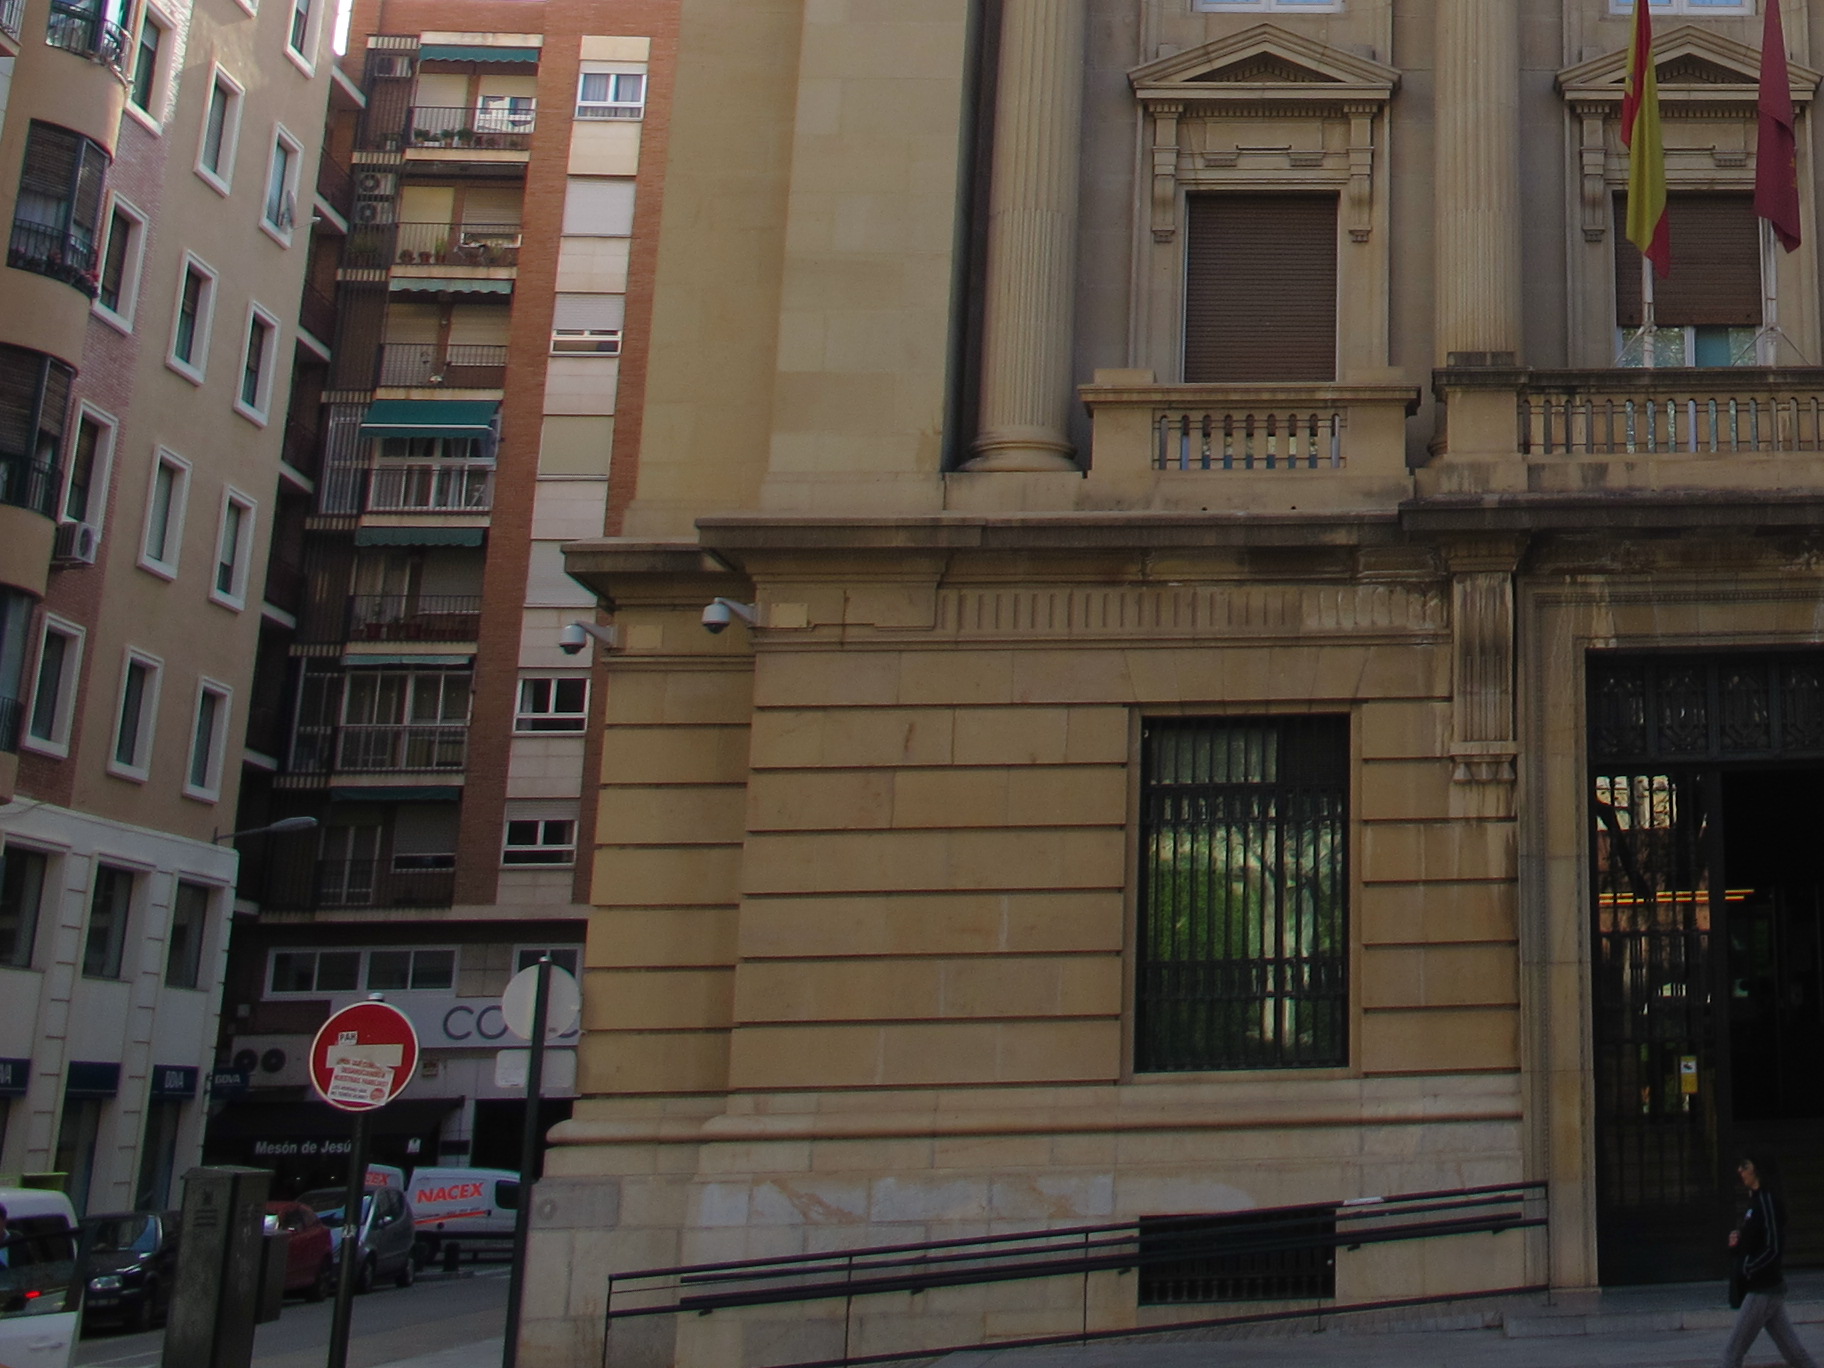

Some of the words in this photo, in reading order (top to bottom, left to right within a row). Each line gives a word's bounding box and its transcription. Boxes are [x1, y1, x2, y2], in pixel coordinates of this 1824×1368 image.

[255, 1139, 297, 1155] Mesón
[301, 1140, 317, 1154] de
[320, 1139, 352, 1154] Jesú
[416, 1182, 484, 1204] NACEX
